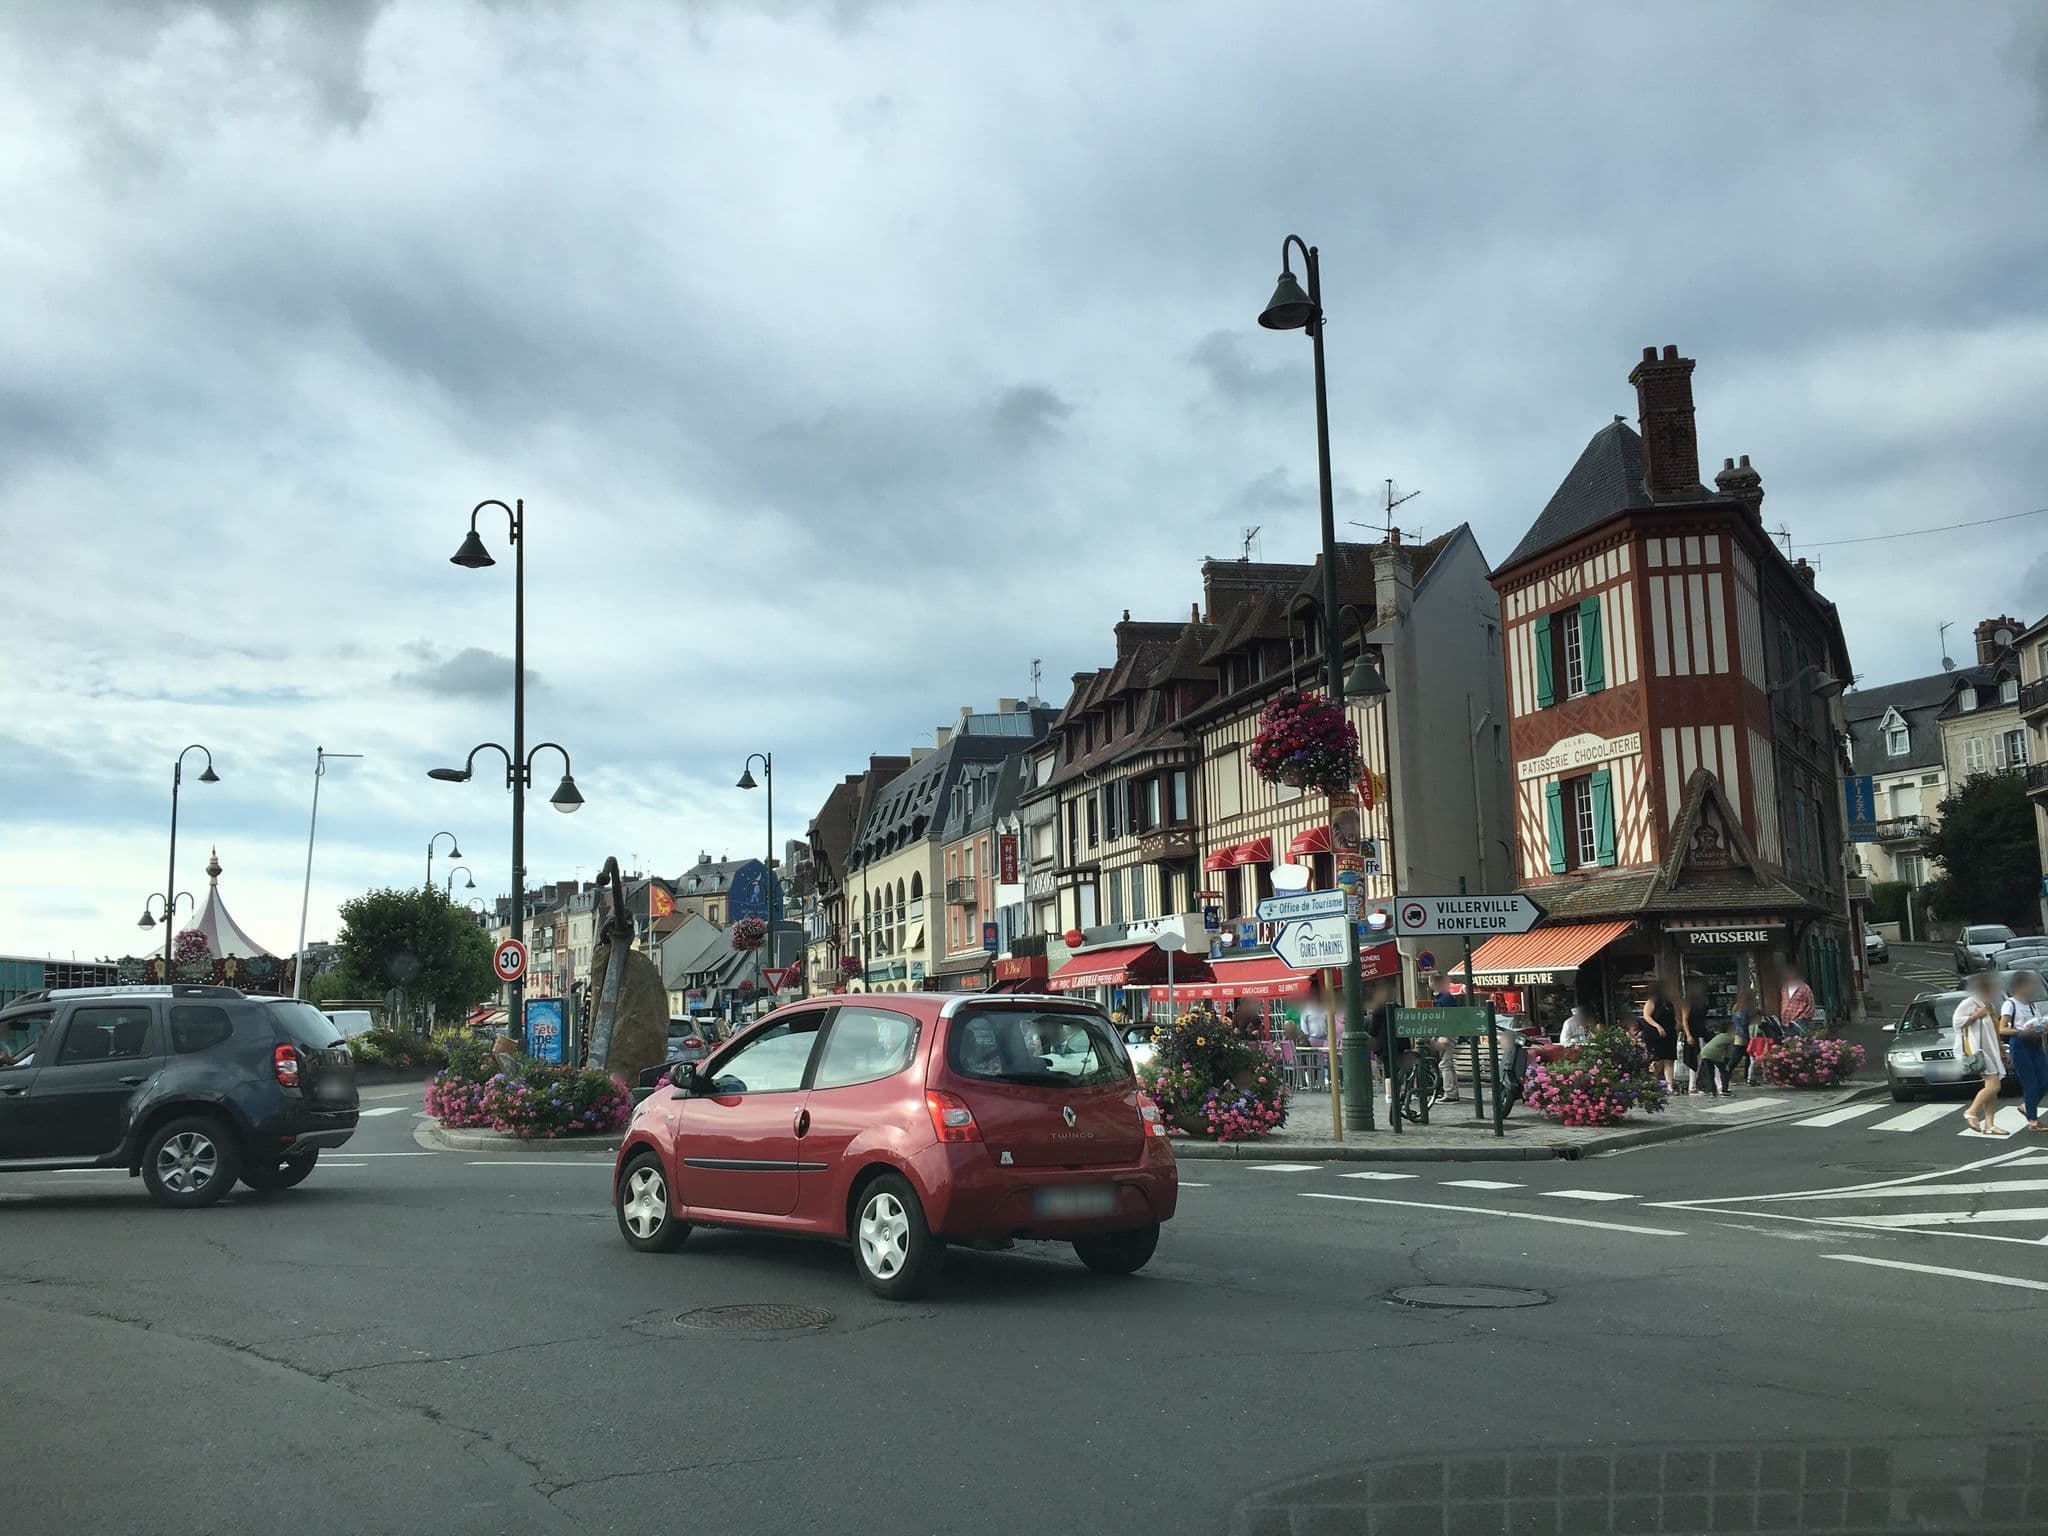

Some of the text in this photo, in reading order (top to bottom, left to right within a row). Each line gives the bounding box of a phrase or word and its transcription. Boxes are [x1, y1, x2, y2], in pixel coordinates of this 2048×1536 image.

[1855, 778, 1866, 820] PIZZA
[1366, 861, 1380, 874] ffe
[1279, 902, 1299, 914] Office
[1301, 902, 1310, 912] de
[1312, 898, 1343, 910] Tourisme
[1437, 900, 1519, 914] VILLERVILLE
[1437, 917, 1507, 930] HONFLEUR
[1256, 922, 1270, 945] LE
[1690, 930, 1768, 944] PATISSERIE
[1300, 939, 1343, 957] CURES MARINES
[501, 951, 520, 969] 30
[1472, 974, 1510, 986] ATISSERIE
[1396, 1009, 1446, 1022] Hautpoul
[533, 1024, 558, 1035] Fête
[1397, 1025, 1438, 1036] Cordier
